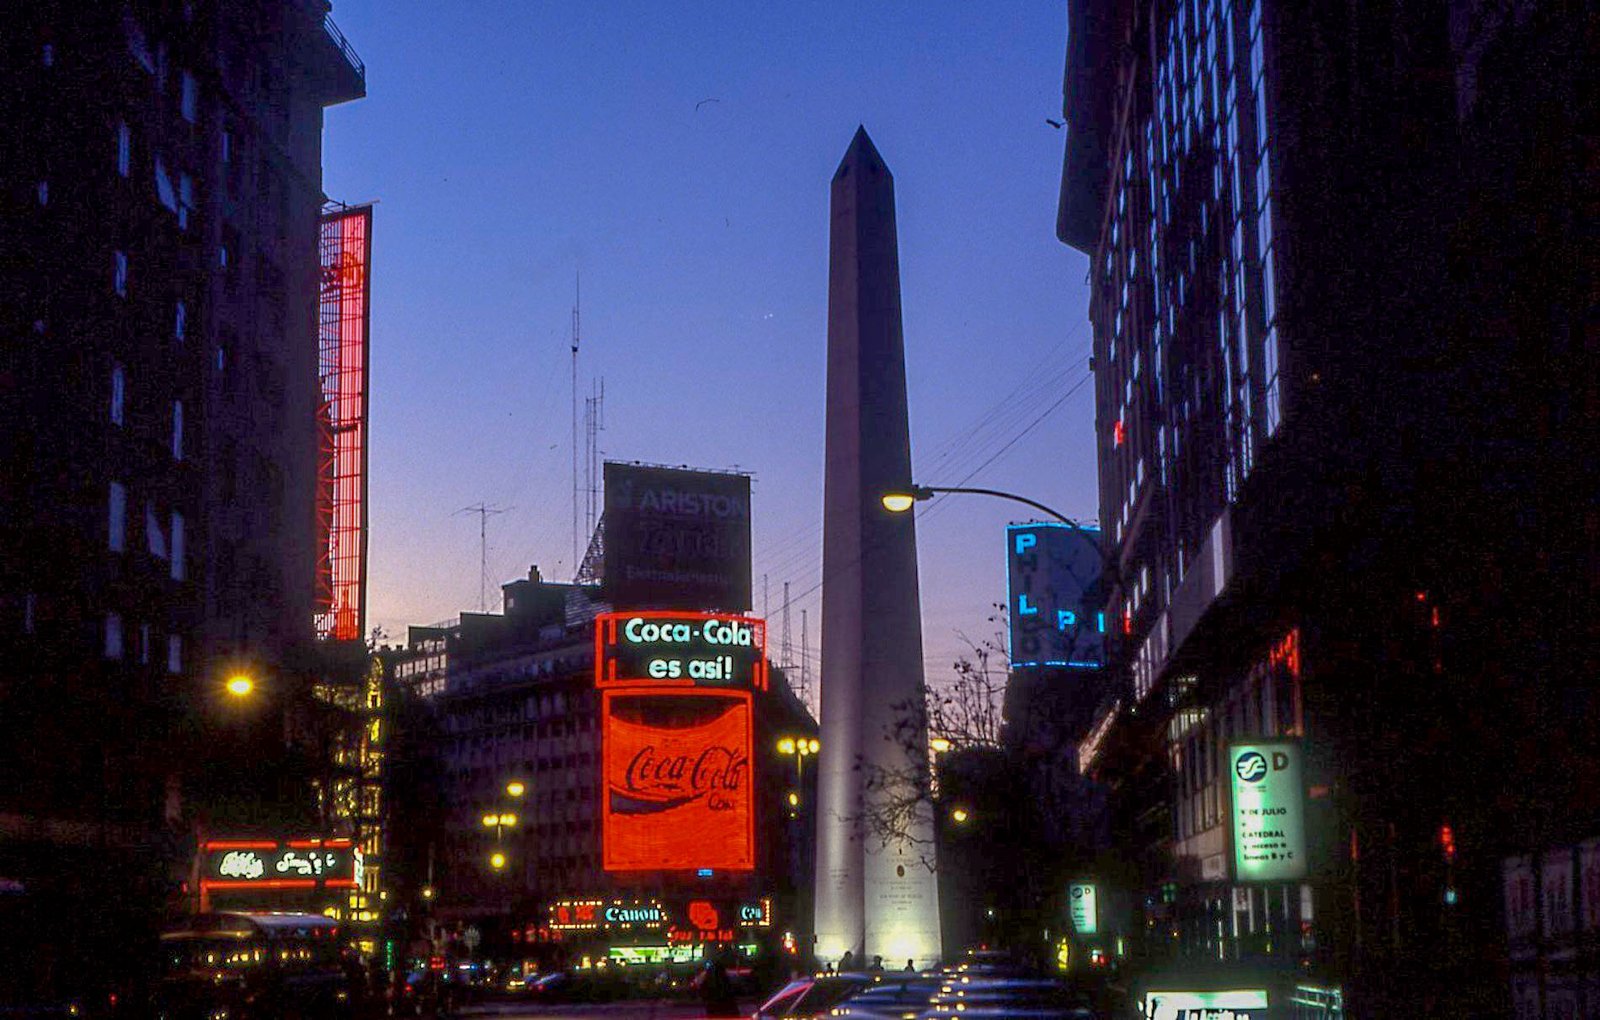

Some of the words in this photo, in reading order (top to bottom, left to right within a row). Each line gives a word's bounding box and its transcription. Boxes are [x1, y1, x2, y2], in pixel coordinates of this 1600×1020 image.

[625, 618, 751, 647] Coca-Cola
[648, 659, 682, 680] es
[688, 656, 732, 680] así!
[625, 745, 748, 792] Coca-Cola
[1272, 752, 1289, 772] D
[1262, 807, 1287, 816] JULIO
[1242, 830, 1285, 839] CATEDRAL
[605, 906, 660, 922] Canon
